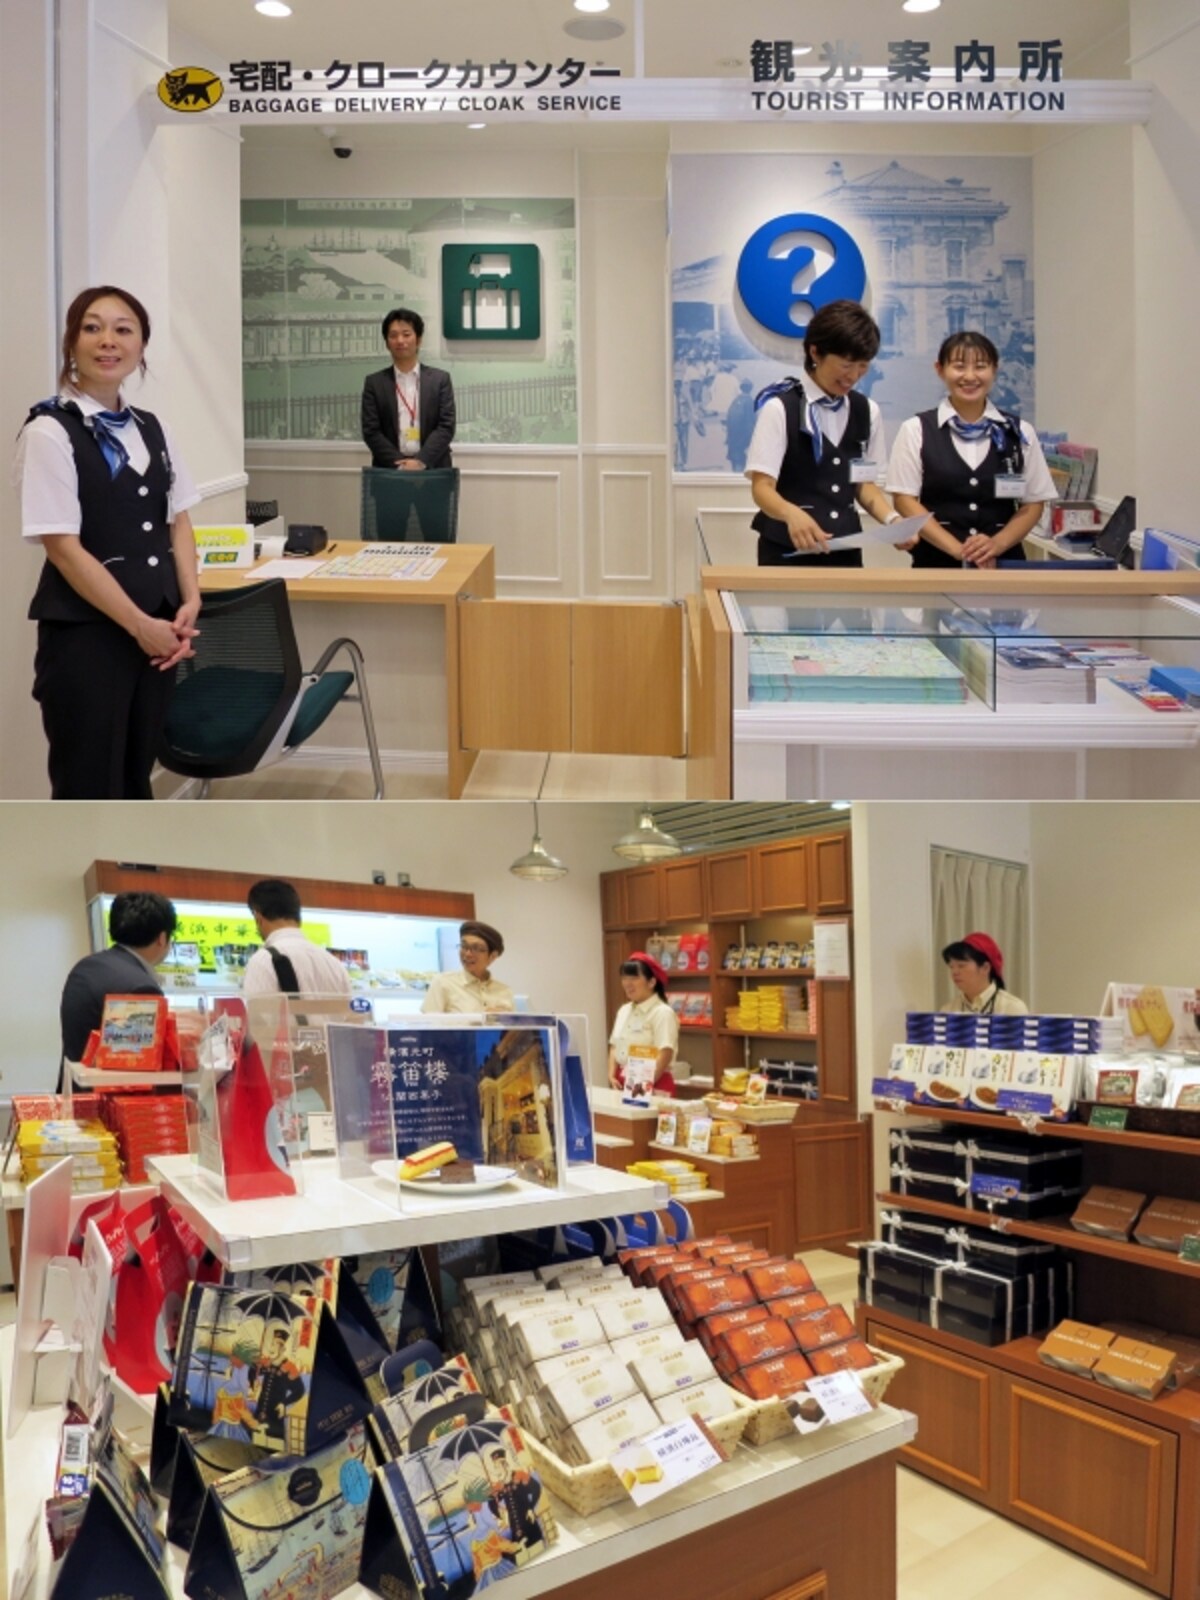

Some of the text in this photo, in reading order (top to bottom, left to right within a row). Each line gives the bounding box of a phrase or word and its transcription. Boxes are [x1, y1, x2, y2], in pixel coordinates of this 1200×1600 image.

[750, 39, 1064, 82] 観光案内所
[228, 60, 621, 92] 宅配・クロークカウンター
[228, 96, 621, 112] BAGGAGE DELIVERY / CLOAK SERVICE
[751, 91, 1064, 111] TOURIST INFORMATION
